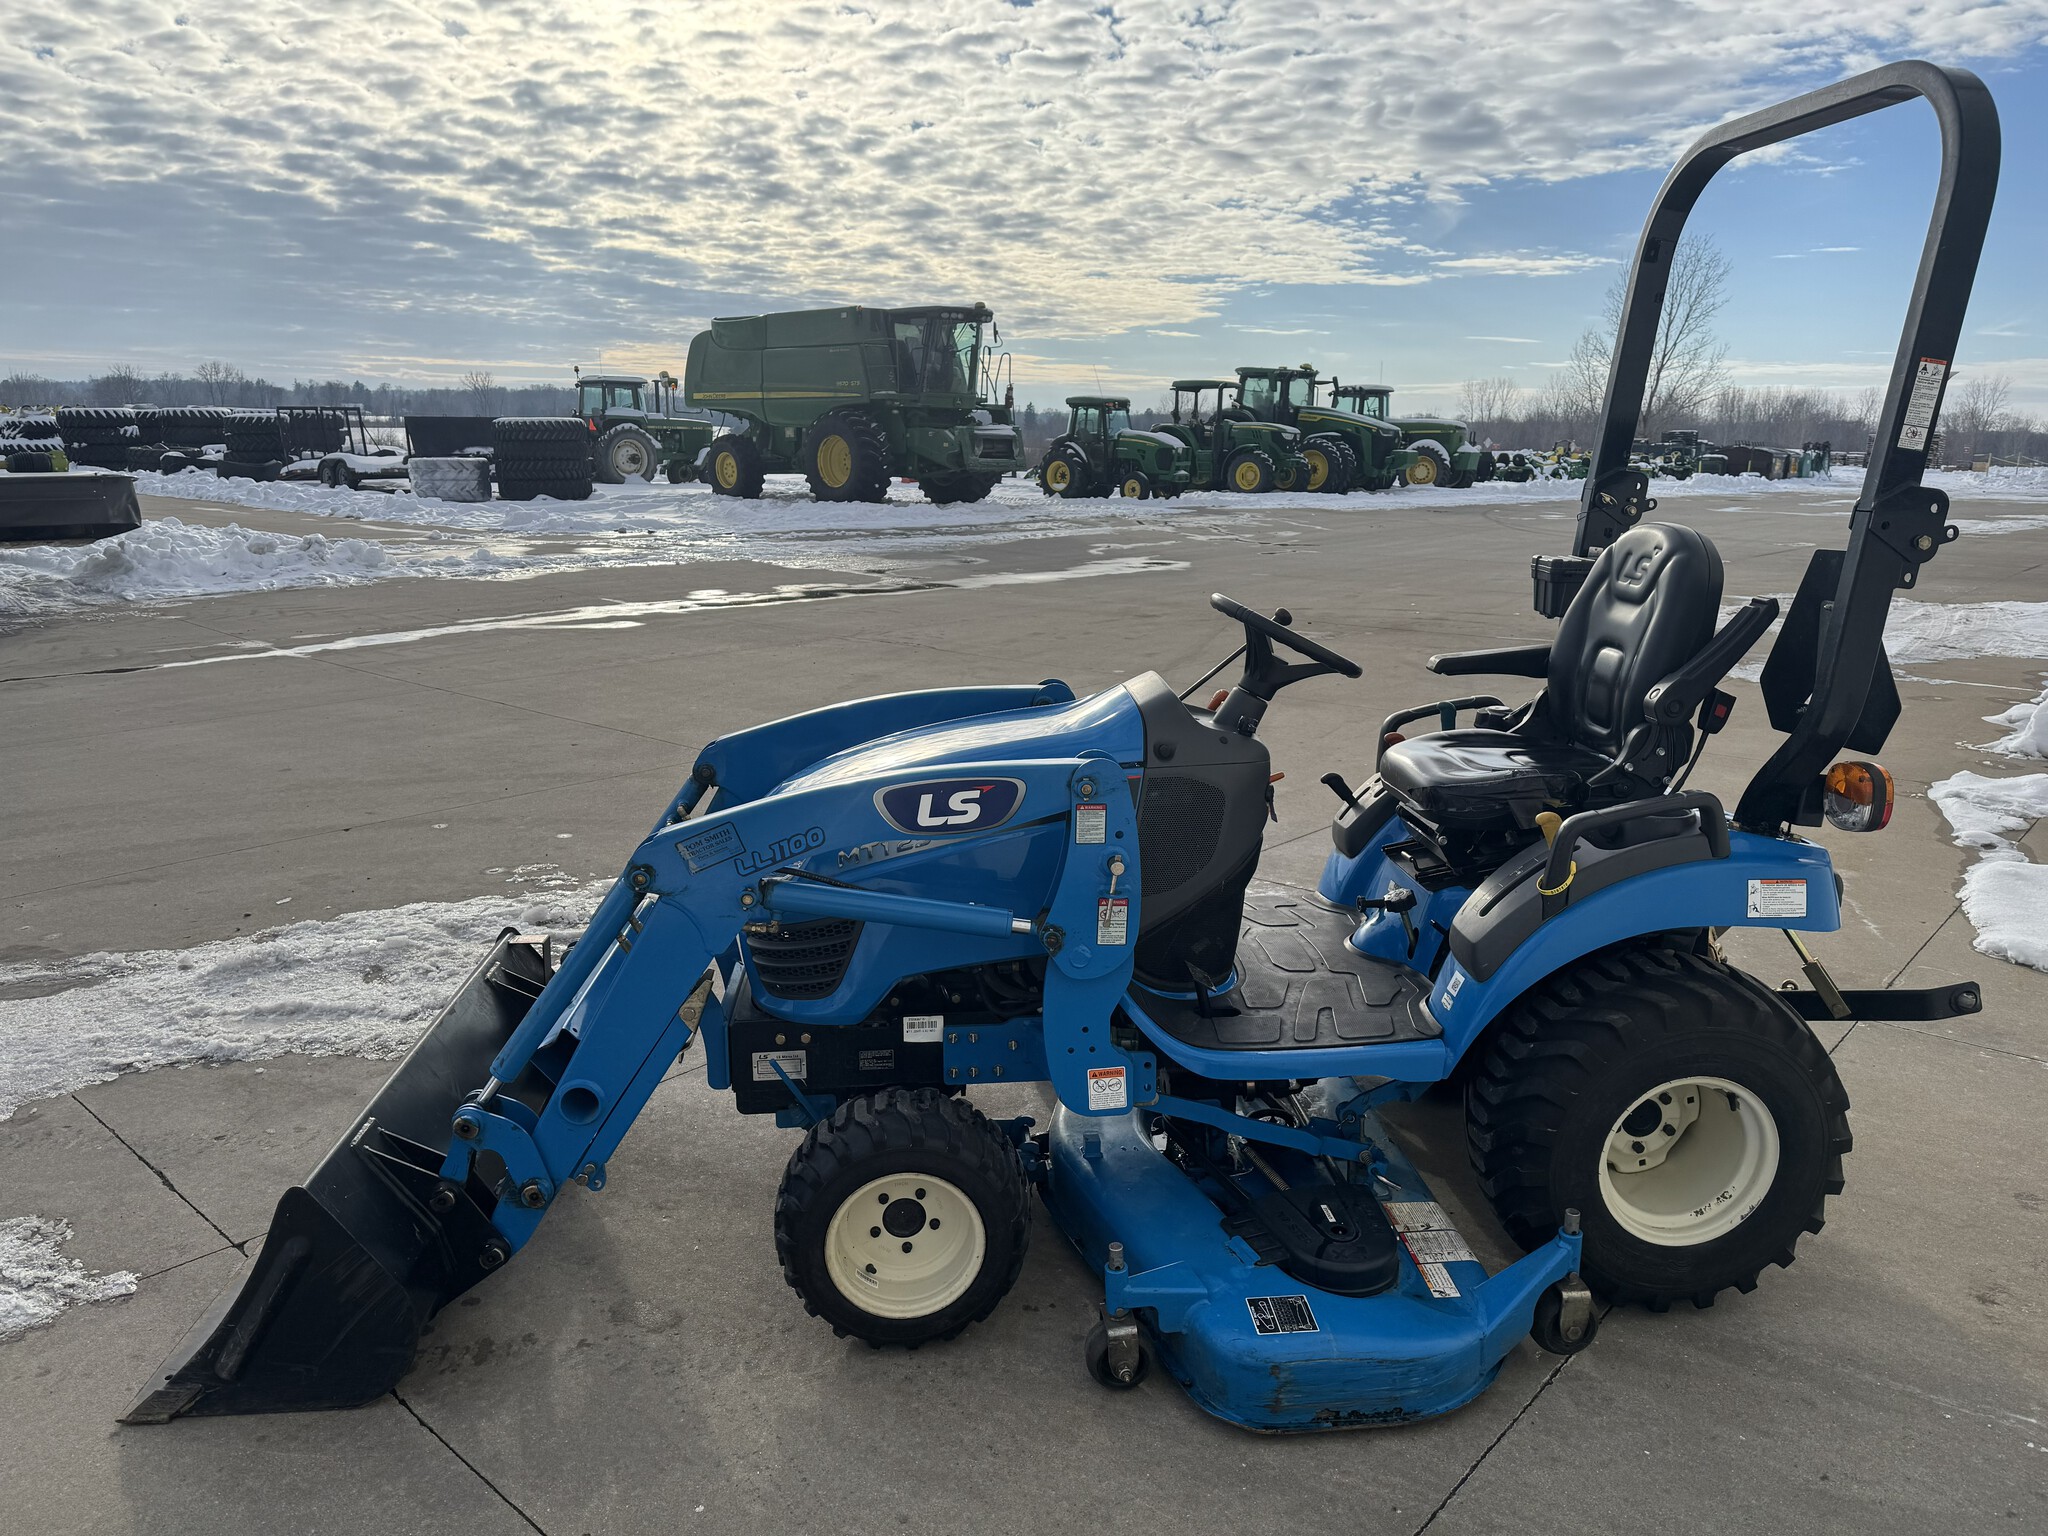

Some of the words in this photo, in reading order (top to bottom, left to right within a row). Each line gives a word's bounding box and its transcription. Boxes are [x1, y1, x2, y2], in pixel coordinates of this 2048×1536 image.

[1616, 548, 1655, 587] LS
[917, 789, 981, 827] LS
[684, 838, 704, 852] TOM
[704, 828, 731, 844] SMITH
[687, 843, 715, 857] TRACTOR
[714, 835, 733, 847] SALES
[733, 826, 826, 877] LL1100
[1097, 1069, 1123, 1077] WARNING
